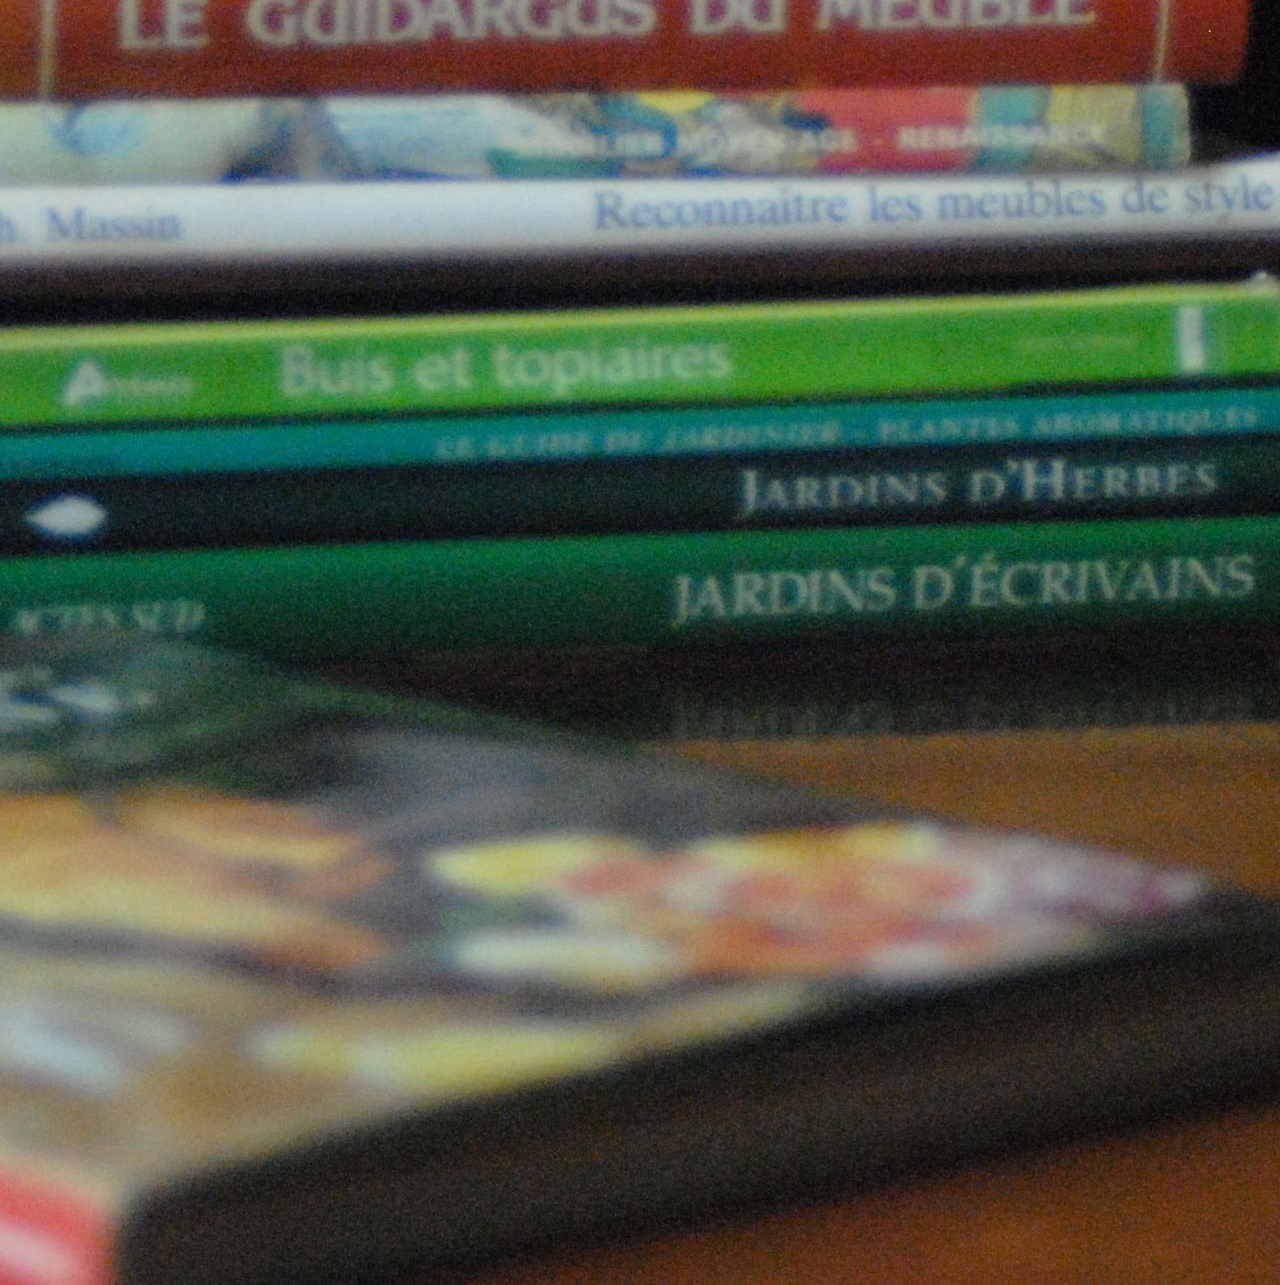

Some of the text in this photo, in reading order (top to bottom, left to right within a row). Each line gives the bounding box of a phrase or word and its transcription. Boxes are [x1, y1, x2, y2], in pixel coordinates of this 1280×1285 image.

[869, 185, 925, 222] les
[937, 178, 1107, 219] meubles
[1121, 177, 1169, 215] de
[1183, 173, 1276, 219] style
[45, 204, 184, 243] Massin
[280, 337, 732, 400] Buis et topiaires
[878, 415, 1022, 442] PLANTES
[1032, 405, 1259, 436] AROMATIQUES
[741, 467, 948, 516] JARDINS
[674, 551, 1258, 627] JARDINS D'ÉCRIVAINS
